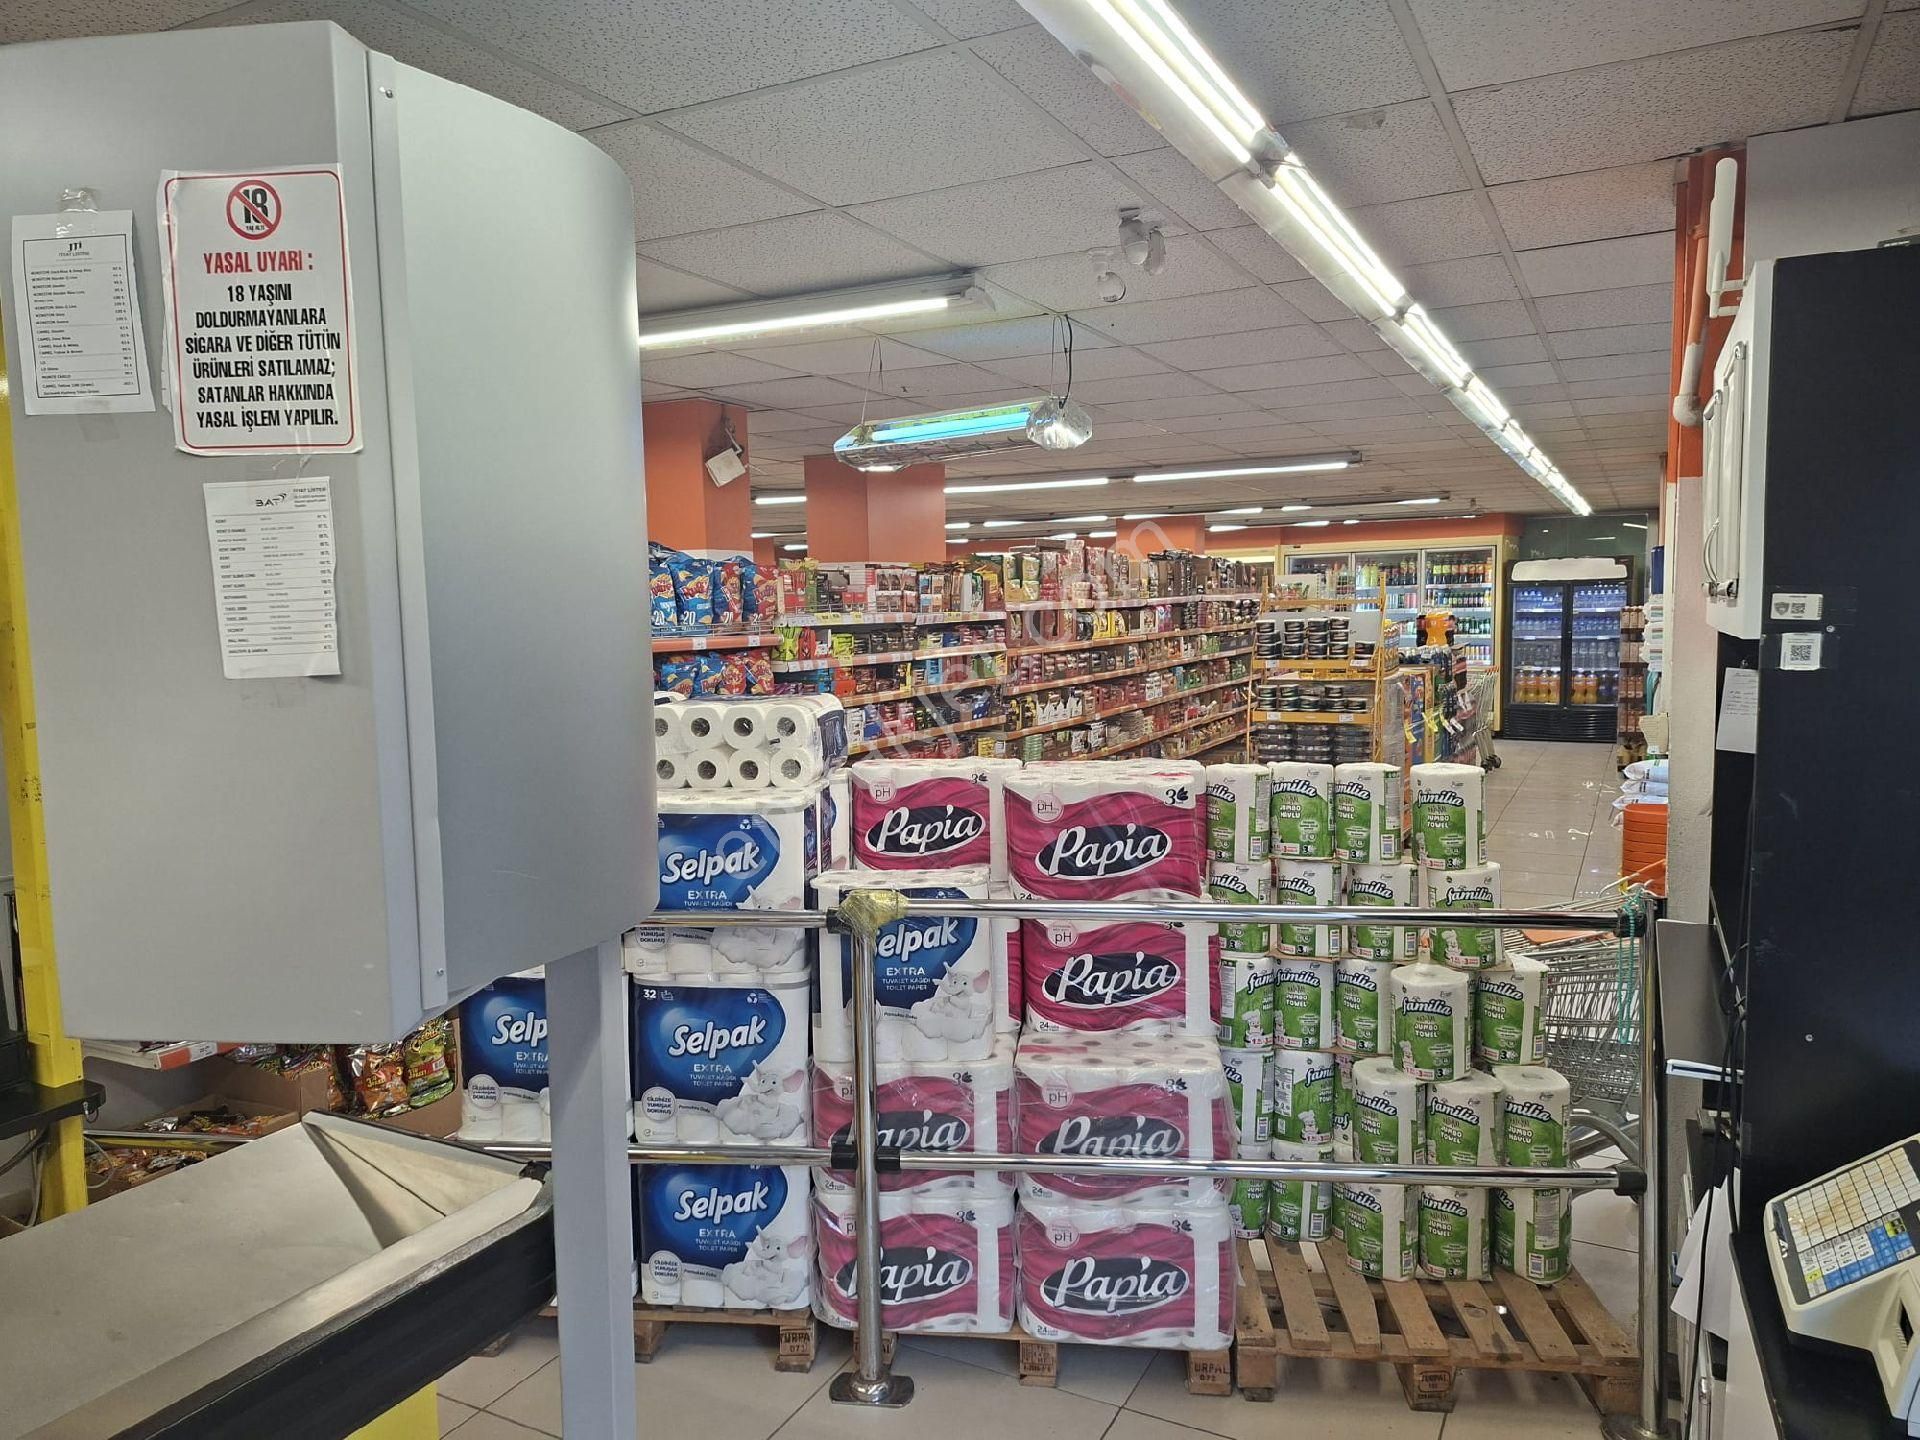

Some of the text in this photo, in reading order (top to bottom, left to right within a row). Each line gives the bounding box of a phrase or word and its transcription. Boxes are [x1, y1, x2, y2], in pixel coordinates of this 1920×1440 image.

[204, 252, 252, 274] YASAL
[257, 250, 303, 272] UYARI
[227, 283, 292, 306] 18 YAŞINI
[195, 308, 326, 329] DOLDURMAYANLARA
[185, 329, 341, 354] SİGARA VE DİĞER TÜTÜN
[192, 355, 335, 379] ÜRÜNLERİ SATILAMAZ;
[198, 384, 334, 404] SATANLAR HAKKINDA
[196, 406, 339, 433] YASAL İŞLEM YAPILIR.
[653, 611, 665, 625] 20
[683, 611, 695, 625] 20
[875, 784, 891, 799] pH
[1165, 787, 1178, 805] 3
[1206, 784, 1236, 802] milia
[1417, 790, 1464, 808] familia
[1036, 801, 1053, 813] pH
[876, 805, 978, 853] Papia
[1047, 824, 1166, 876] Papia
[661, 844, 760, 886] Selpak
[1211, 874, 1247, 893] milia
[687, 889, 727, 901] EXTRA
[1446, 886, 1493, 906] familia
[1054, 930, 1072, 944] pH
[886, 967, 926, 977] EXTRA
[1056, 951, 1177, 1003] Papia
[1276, 969, 1321, 988] familia
[1336, 969, 1376, 992] familia
[1248, 970, 1274, 995] fami
[1478, 976, 1524, 1000] familia
[643, 989, 657, 999] 32
[1286, 1000, 1307, 1008] TOWEL
[1402, 997, 1452, 1016] familia
[491, 1011, 548, 1047] Selp
[1039, 1021, 1050, 1030] 24
[1414, 1023, 1439, 1031] JUMBO
[1415, 1030, 1438, 1038] TOWEL
[668, 1015, 768, 1059] Selpak
[693, 1063, 732, 1073] EXTRA
[1305, 1066, 1333, 1088] fami
[1048, 1091, 1067, 1104] pH
[1431, 1097, 1479, 1125] familia
[1054, 1115, 1172, 1155] Papia
[1440, 1125, 1462, 1137] JUMBO
[1440, 1133, 1461, 1144] TOWEL
[1507, 1126, 1533, 1137] JUMBO
[825, 1180, 834, 1190] 24
[1032, 1186, 1043, 1194] 24
[674, 1182, 768, 1224] Selpak
[1421, 1192, 1467, 1216] familia
[956, 1210, 965, 1223] 3
[1428, 1220, 1452, 1231] JUMBO
[699, 1228, 736, 1238] EXTRA
[1054, 1231, 1072, 1244] pH
[1428, 1227, 1451, 1237] TOWEL
[1054, 1256, 1182, 1312] Papia
